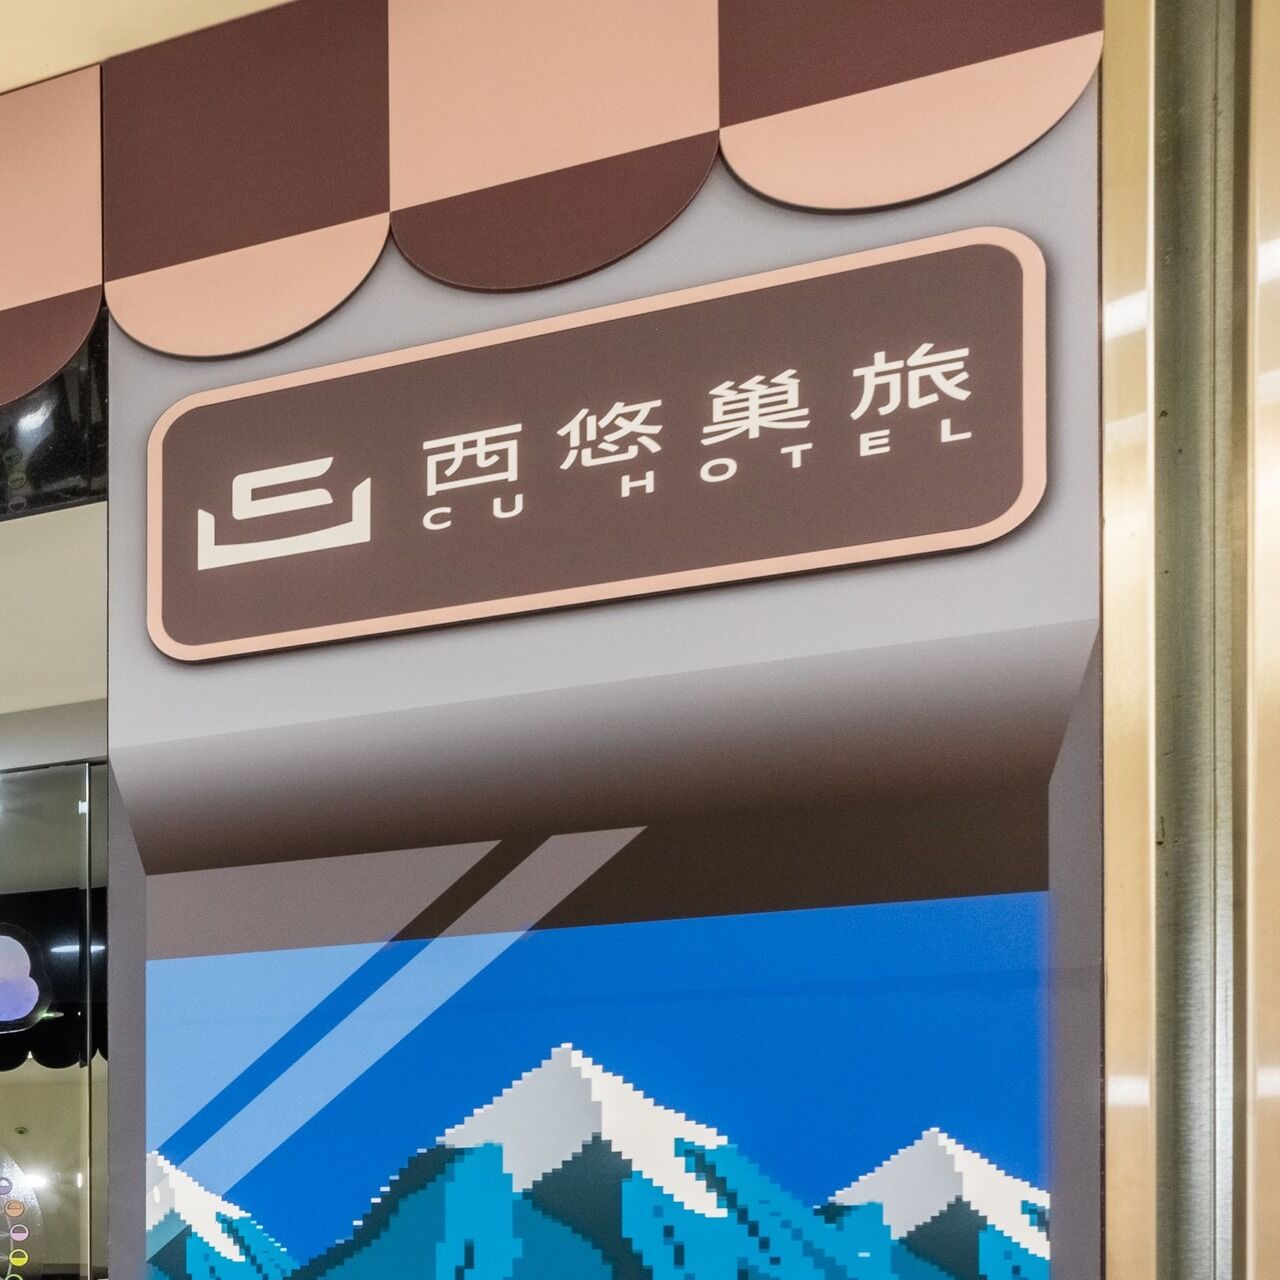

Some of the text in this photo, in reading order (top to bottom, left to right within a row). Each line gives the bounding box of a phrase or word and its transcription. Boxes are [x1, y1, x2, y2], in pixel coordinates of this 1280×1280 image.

[422, 342, 973, 496] 西悠巢旅
[422, 426, 973, 531] CU HOTEL
